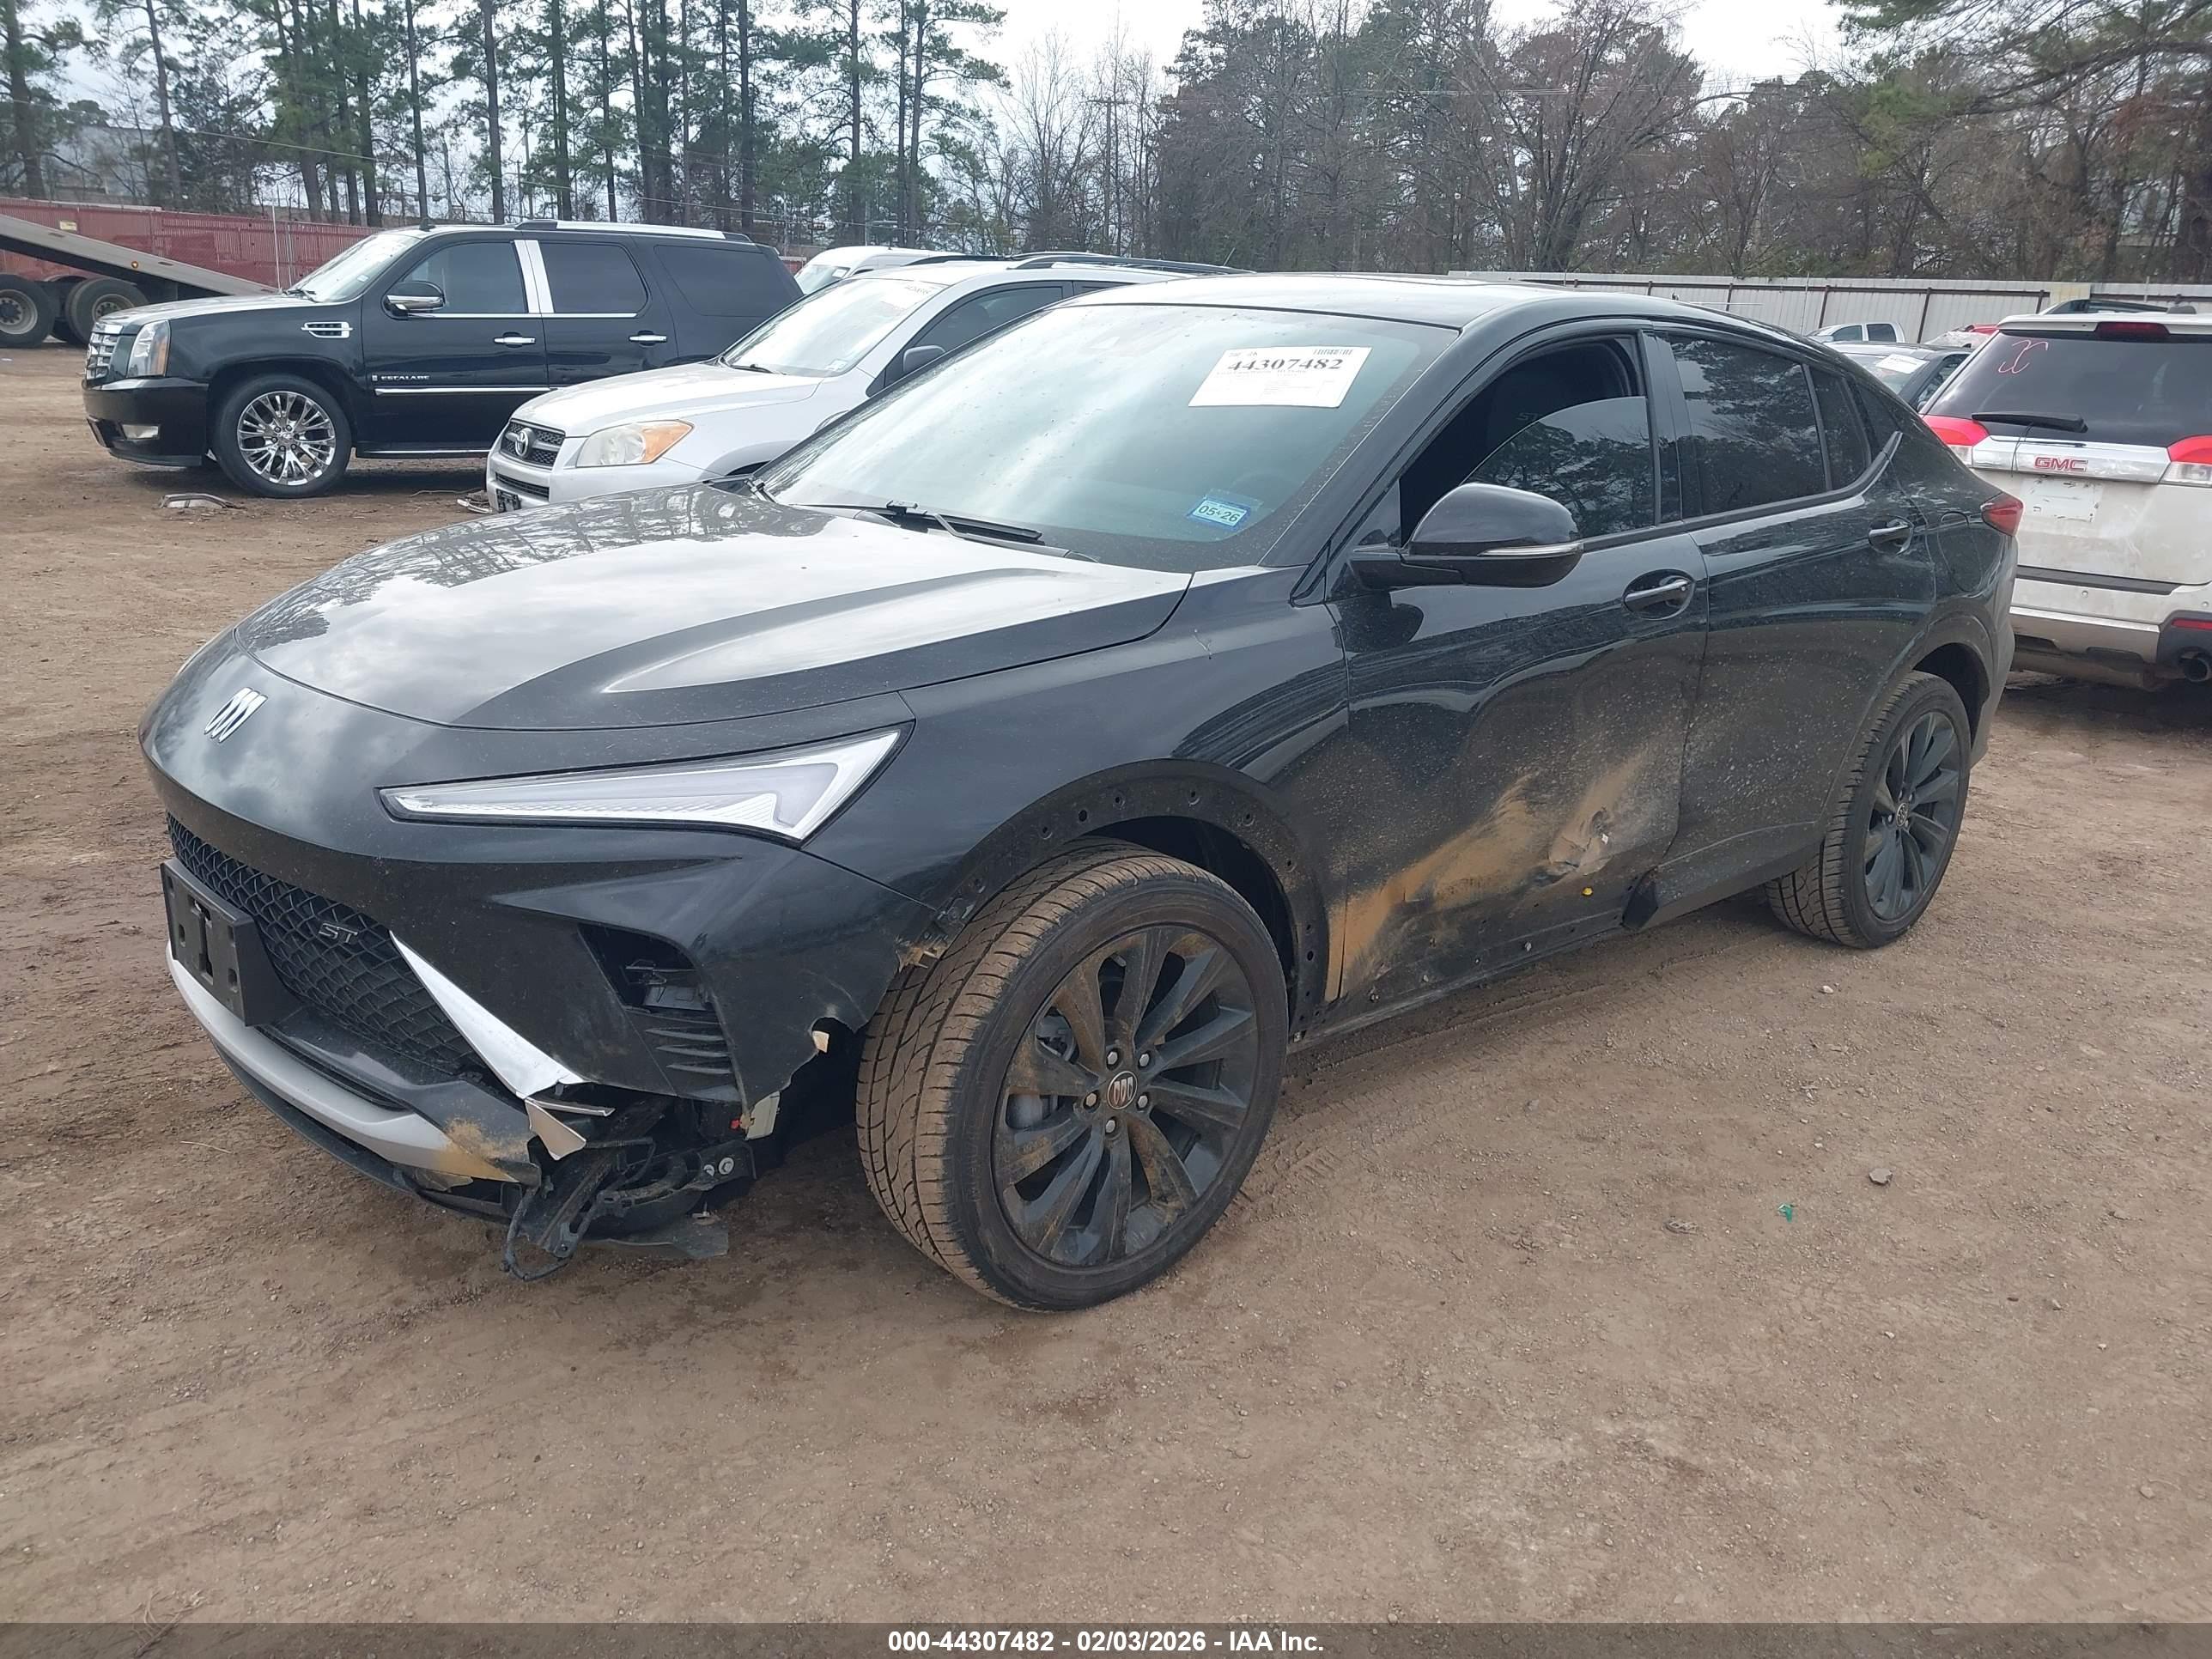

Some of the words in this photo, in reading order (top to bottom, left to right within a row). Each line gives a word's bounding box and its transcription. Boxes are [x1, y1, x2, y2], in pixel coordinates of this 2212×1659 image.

[1228, 359, 1344, 370] 44307482
[2034, 456, 2088, 472] GMC
[319, 922, 358, 943] ST
